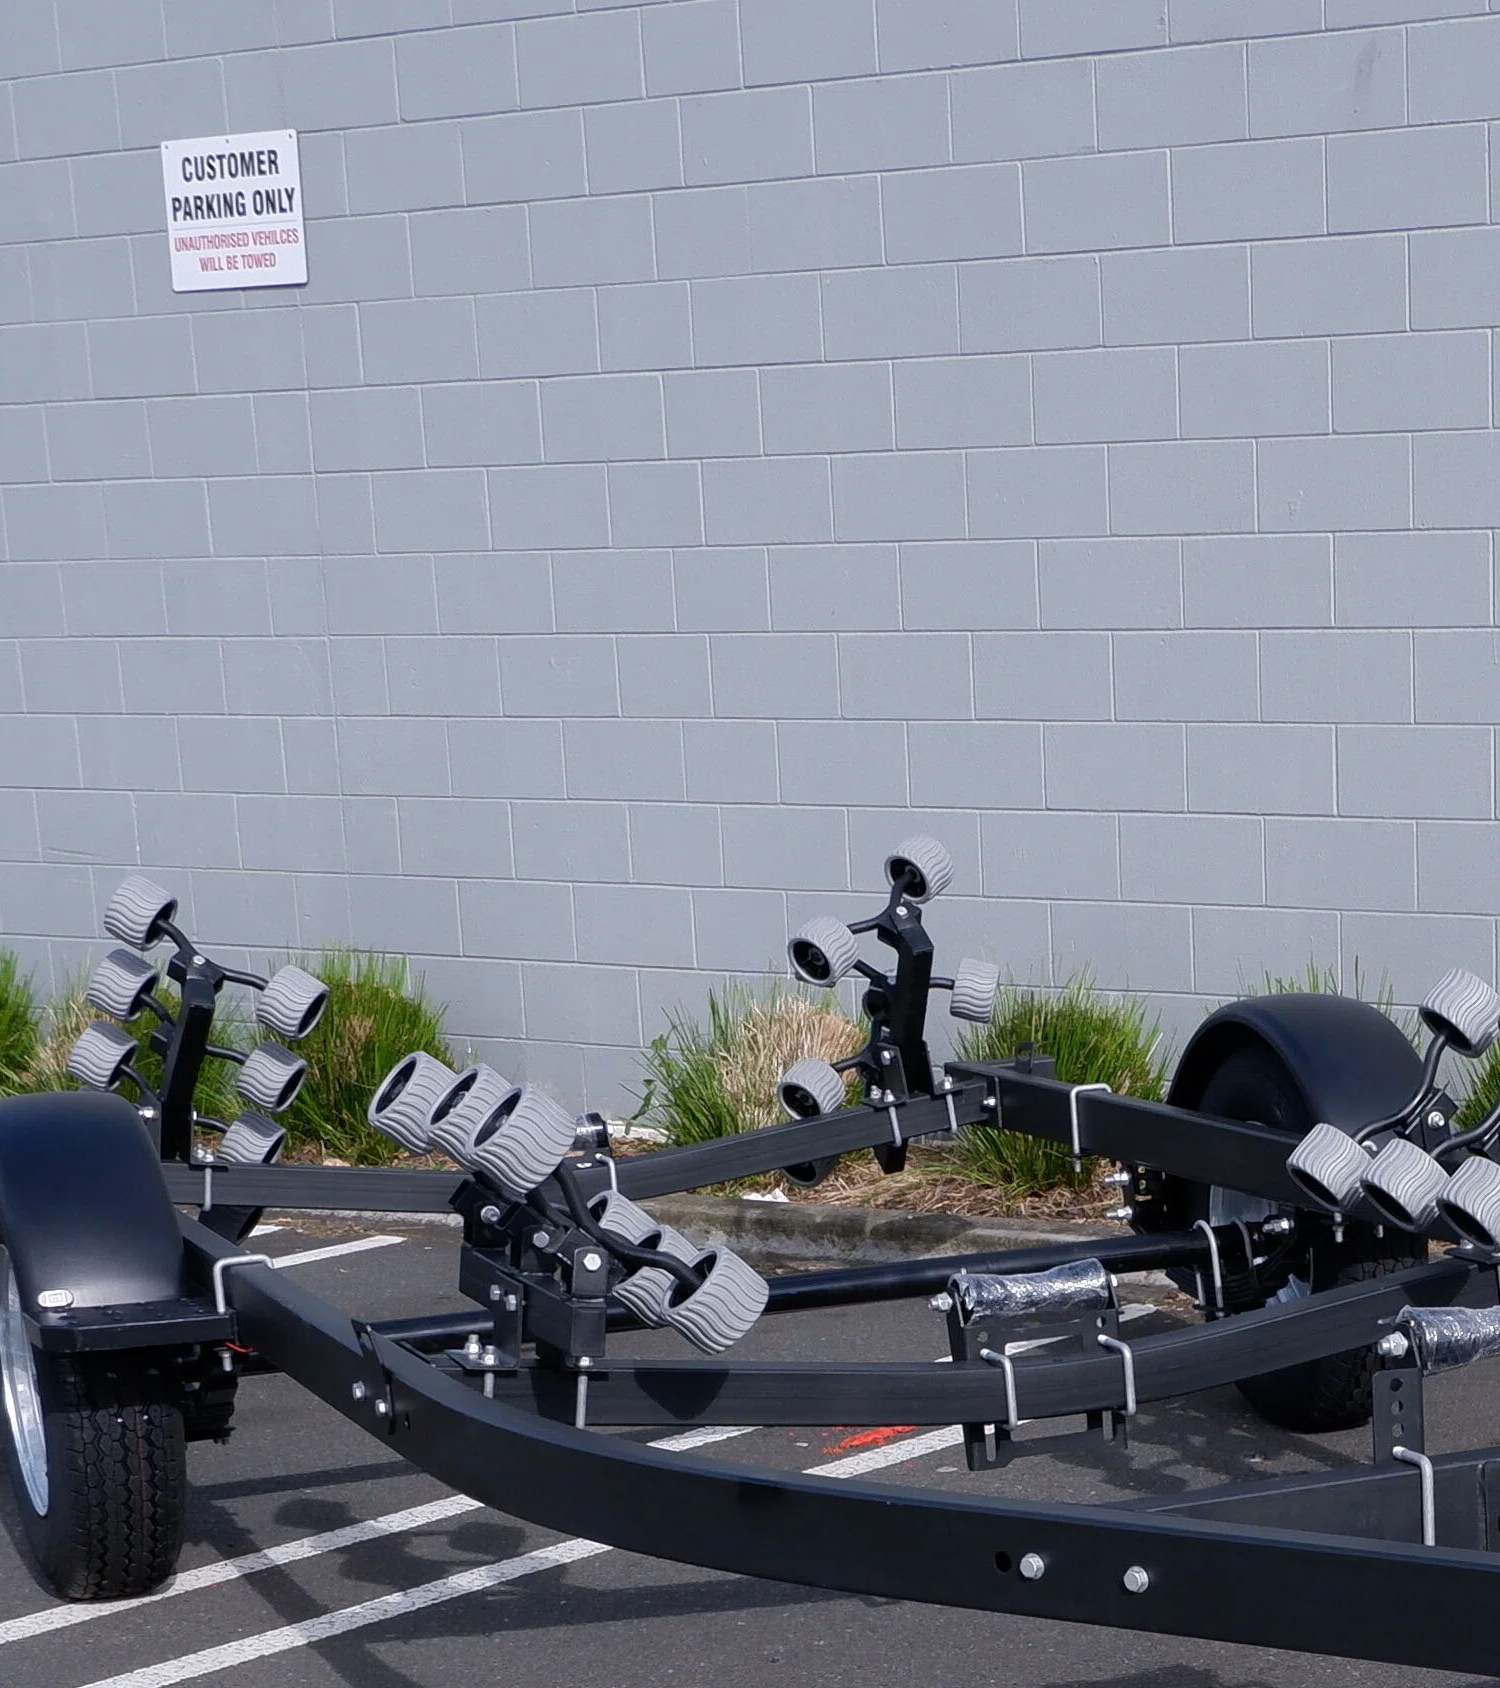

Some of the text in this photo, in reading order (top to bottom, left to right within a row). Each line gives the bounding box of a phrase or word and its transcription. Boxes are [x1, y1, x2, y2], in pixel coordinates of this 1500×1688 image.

[181, 149, 280, 183] CUSTOMER
[171, 187, 295, 222] PARKING ONLY
[174, 232, 249, 252] UNAUTHORISED
[199, 252, 276, 272] WILL BE TOWED
